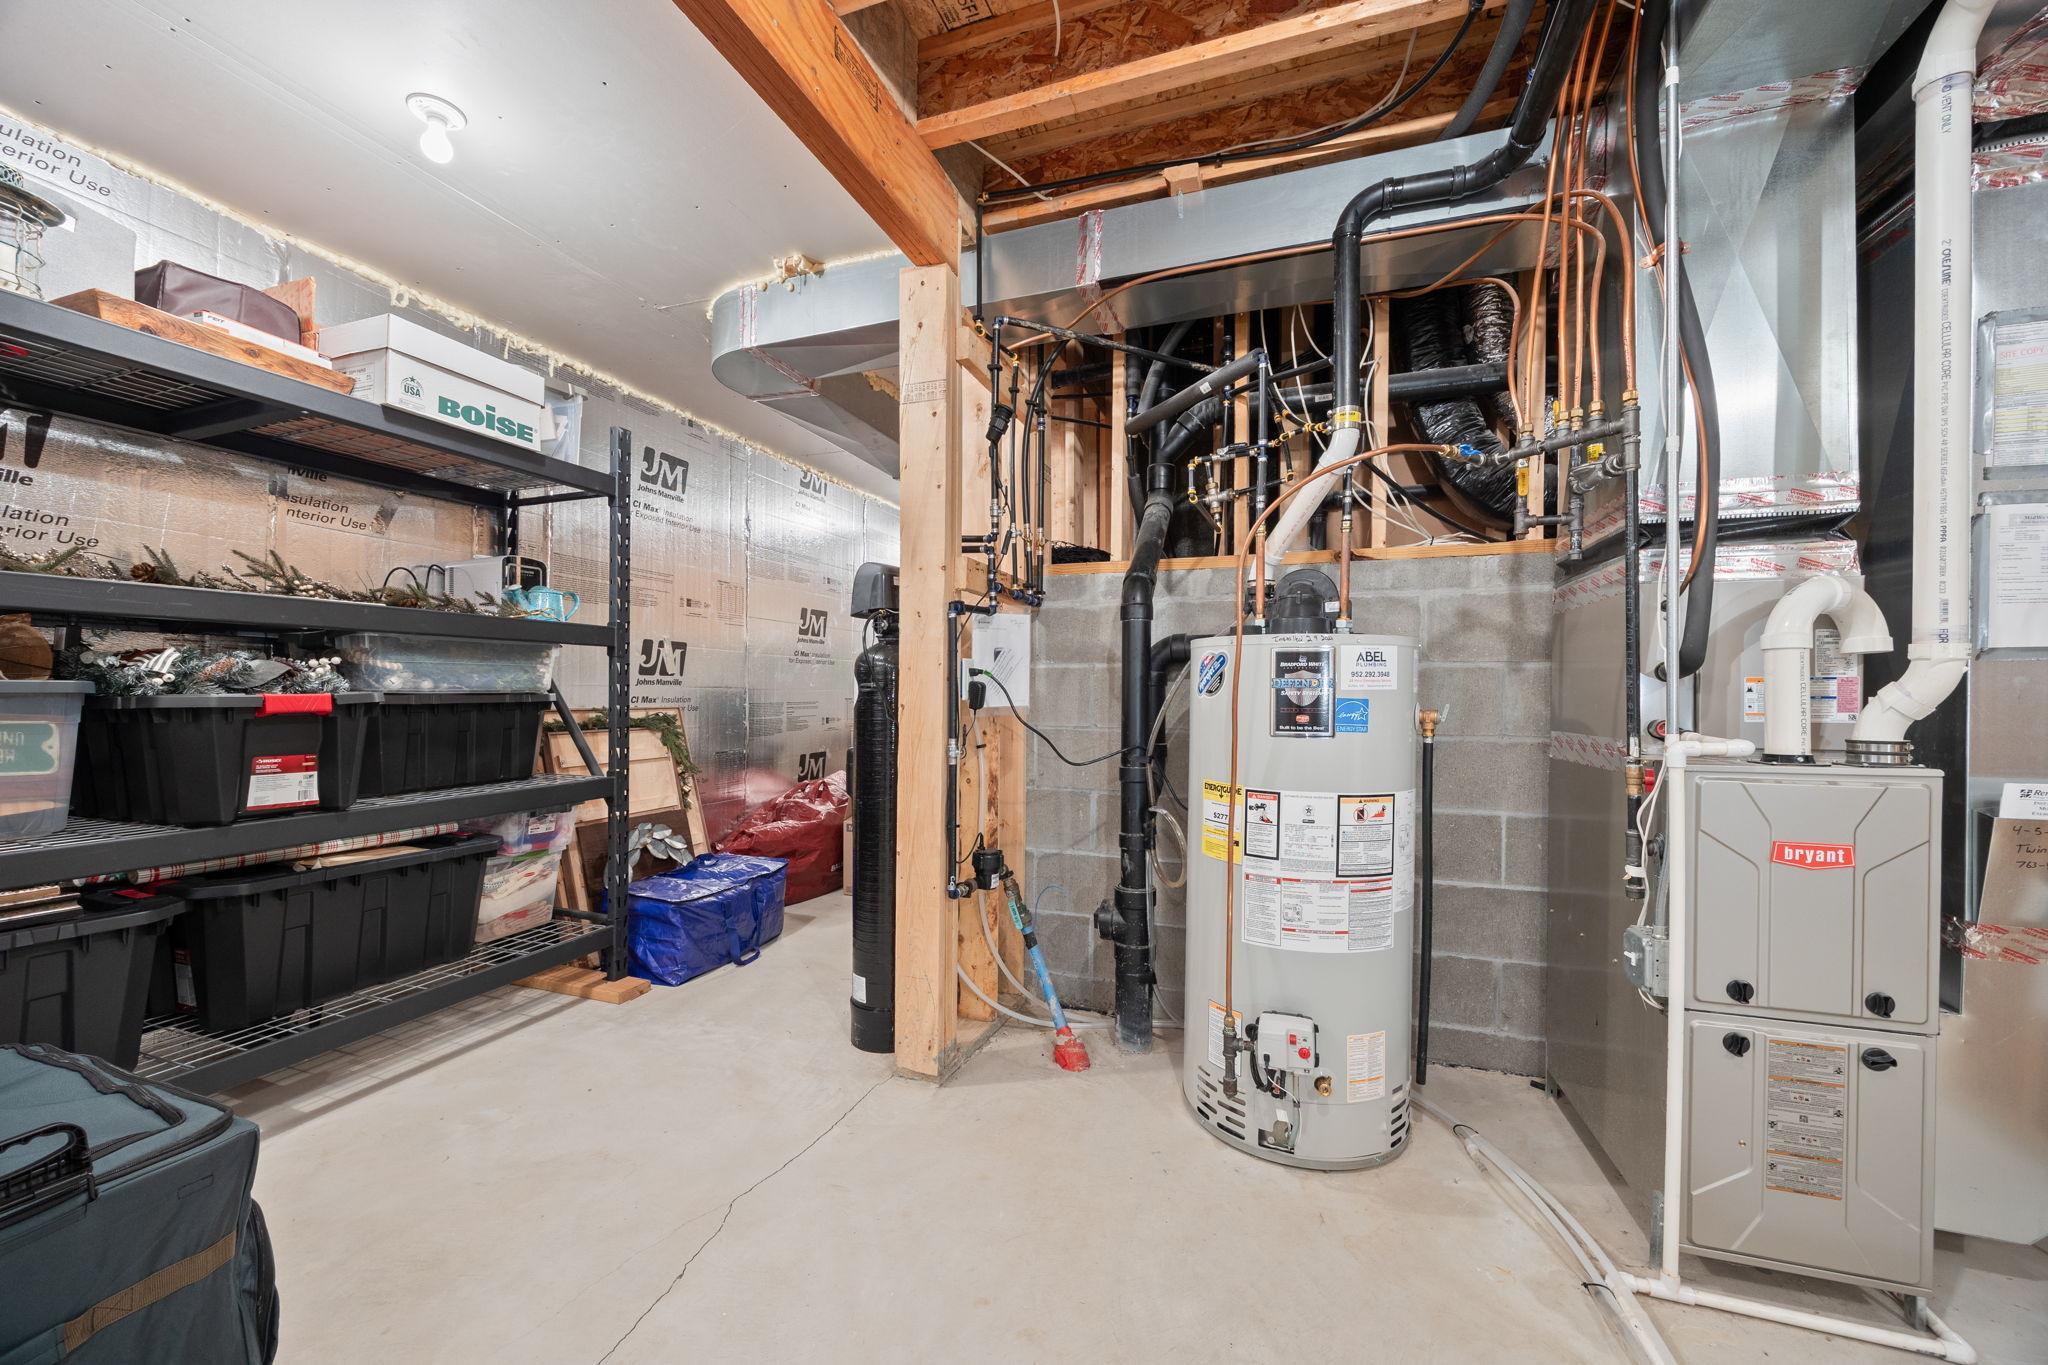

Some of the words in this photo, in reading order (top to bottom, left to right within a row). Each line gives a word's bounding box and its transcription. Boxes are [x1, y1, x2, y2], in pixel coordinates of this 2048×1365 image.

[0, 141, 61, 174] erior
[69, 169, 111, 197] Use
[1940, 321, 1952, 359] CELLULAR
[1940, 360, 1952, 381] CORE
[404, 384, 421, 398] USA
[637, 483, 657, 496] Johns
[657, 490, 685, 504] Manville
[643, 502, 660, 514] Max
[340, 516, 367, 531] Use
[635, 509, 664, 525] Exposed
[664, 516, 688, 529] Interior
[689, 523, 702, 534] Use
[56, 530, 100, 548] Use
[1937, 628, 1949, 644] FOR
[1356, 651, 1387, 662] ABEL
[635, 678, 656, 687] Johns
[656, 678, 683, 687] Manville
[641, 695, 657, 704] Max
[661, 695, 692, 704] Insulation
[687, 704, 699, 713] Use
[1204, 782, 1242, 796] ENERGYGUE
[1784, 846, 1845, 864] bryant
[2015, 843, 2048, 854] Twin
